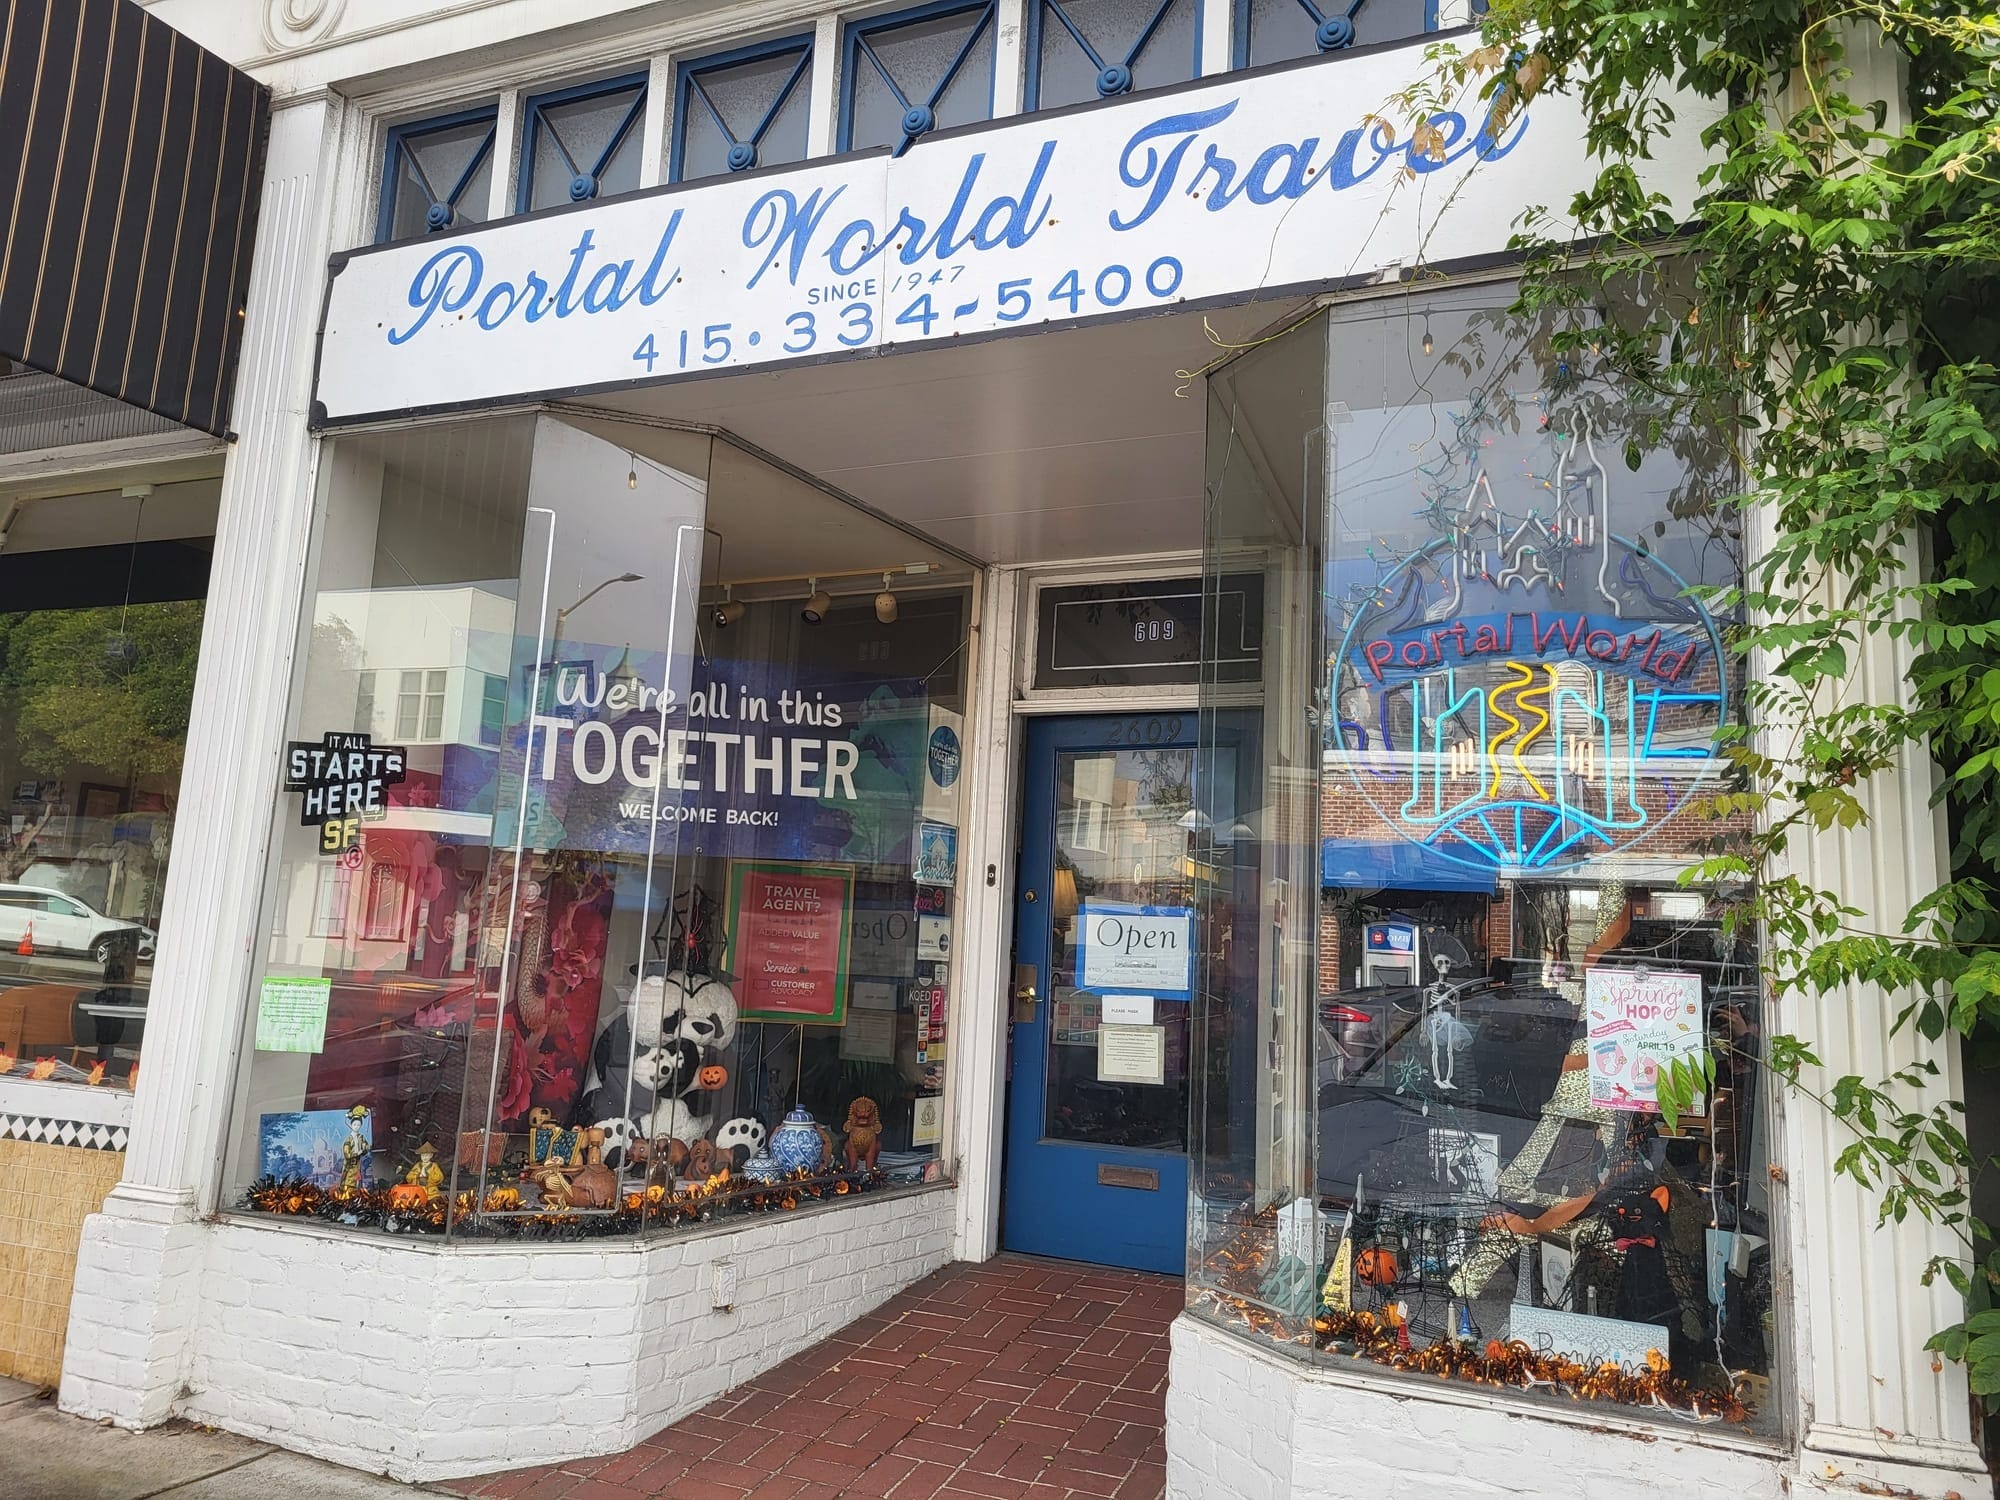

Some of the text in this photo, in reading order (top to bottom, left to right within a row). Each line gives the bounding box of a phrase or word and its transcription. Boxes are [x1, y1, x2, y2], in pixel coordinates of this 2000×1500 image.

[387, 208, 681, 346] Portal
[742, 139, 1053, 289] World
[806, 265, 966, 305] SINCE 1947
[1134, 619, 1175, 642] 609
[1364, 612, 1697, 683] Portal World
[556, 667, 677, 715] We're
[689, 683, 731, 720] all
[740, 685, 772, 725] in
[778, 689, 842, 728] this
[1105, 716, 1183, 745] 2609
[328, 735, 366, 751] IT ALL
[290, 749, 403, 780] STARTS
[533, 715, 861, 801] TOGETHER
[305, 779, 383, 818] HERE
[619, 802, 779, 827] WELCOME BACK!
[323, 818, 359, 850] SF
[764, 885, 821, 900] TRAVEL
[762, 898, 821, 913] AGENT?
[791, 930, 821, 940] VALUE
[1096, 917, 1178, 955] Open
[762, 959, 798, 975] Service
[770, 980, 816, 990] CUSTOMER
[909, 989, 931, 1002] KQED
[1607, 977, 1684, 1021] Spring
[1626, 1003, 1661, 1020] HOP
[1622, 1028, 1669, 1046] Saturday
[1636, 1041, 1662, 1051] APRIL
[1665, 1042, 1676, 1052] 19
[296, 1127, 342, 1143] INDIA
